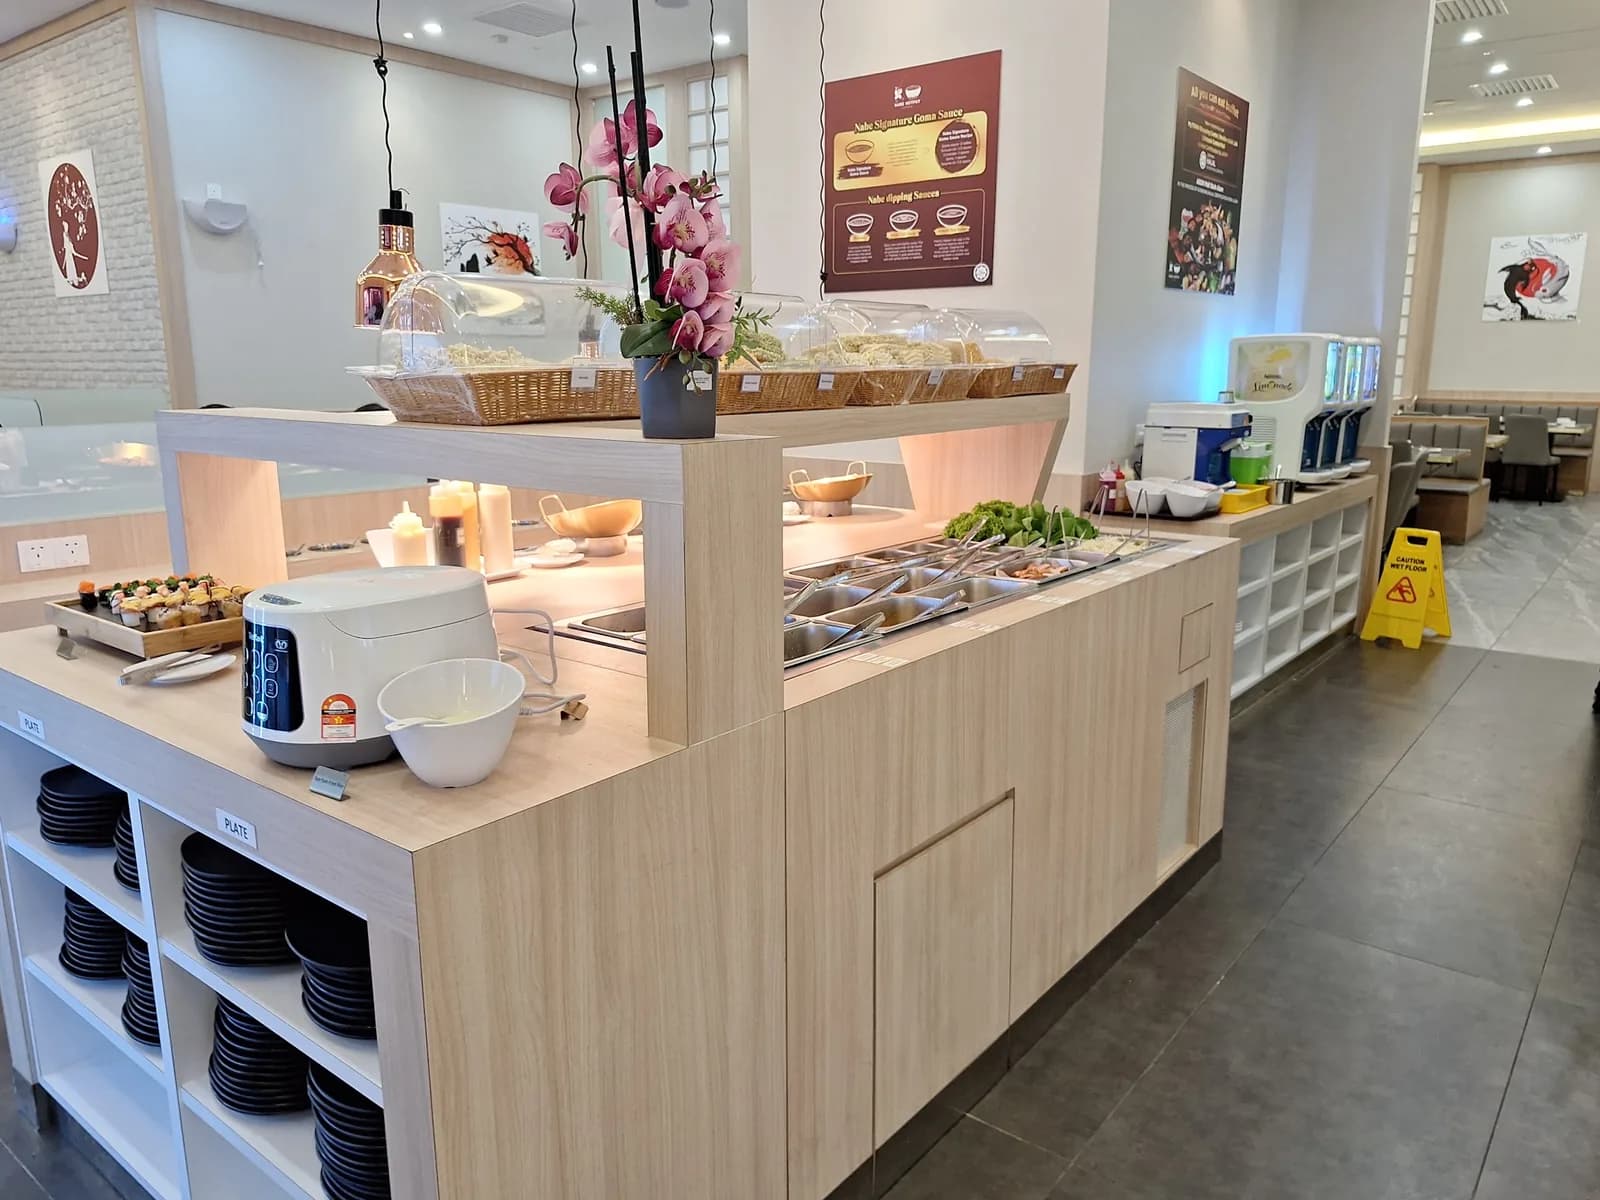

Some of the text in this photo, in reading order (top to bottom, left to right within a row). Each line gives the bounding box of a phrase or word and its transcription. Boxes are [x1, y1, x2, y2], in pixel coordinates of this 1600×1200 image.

[854, 108, 963, 133] Nabe Signature Goma Sauce
[868, 190, 940, 204] Nabe dipping Sauces
[1390, 562, 1427, 572] WET FLOOR
[1396, 556, 1425, 565] CAUTION
[24, 717, 40, 734] PLATE
[224, 816, 249, 841] PLATE
